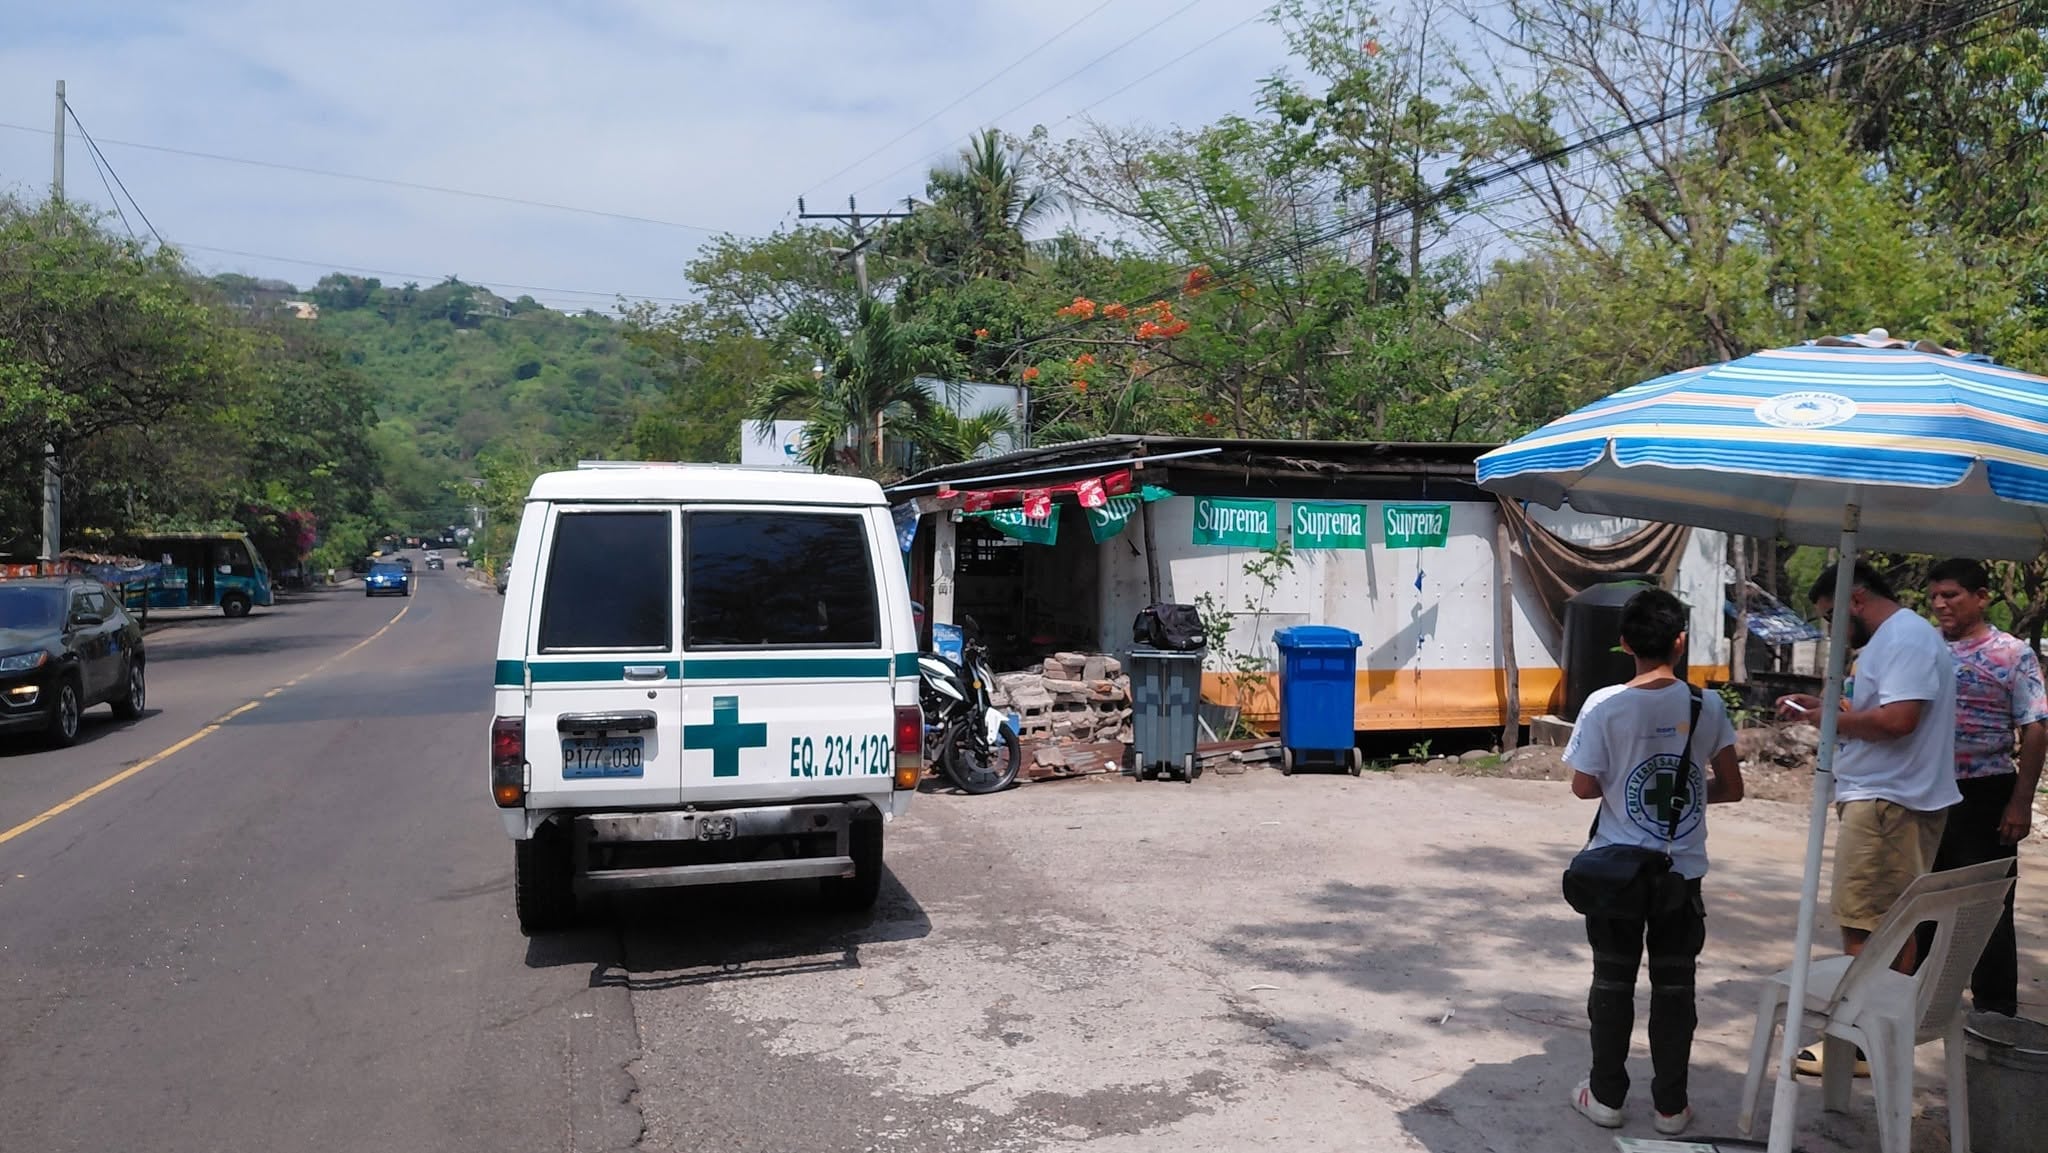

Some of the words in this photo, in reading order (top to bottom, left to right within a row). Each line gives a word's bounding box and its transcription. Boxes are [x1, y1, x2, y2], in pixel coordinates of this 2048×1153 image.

[1198, 500, 1271, 539] Suprema
[1296, 506, 1362, 542] Suprema
[1387, 508, 1442, 542] Suprema
[565, 748, 602, 769] P177
[612, 747, 641, 768] 030
[790, 736, 818, 778] EQ.
[824, 734, 889, 775] 231-120
